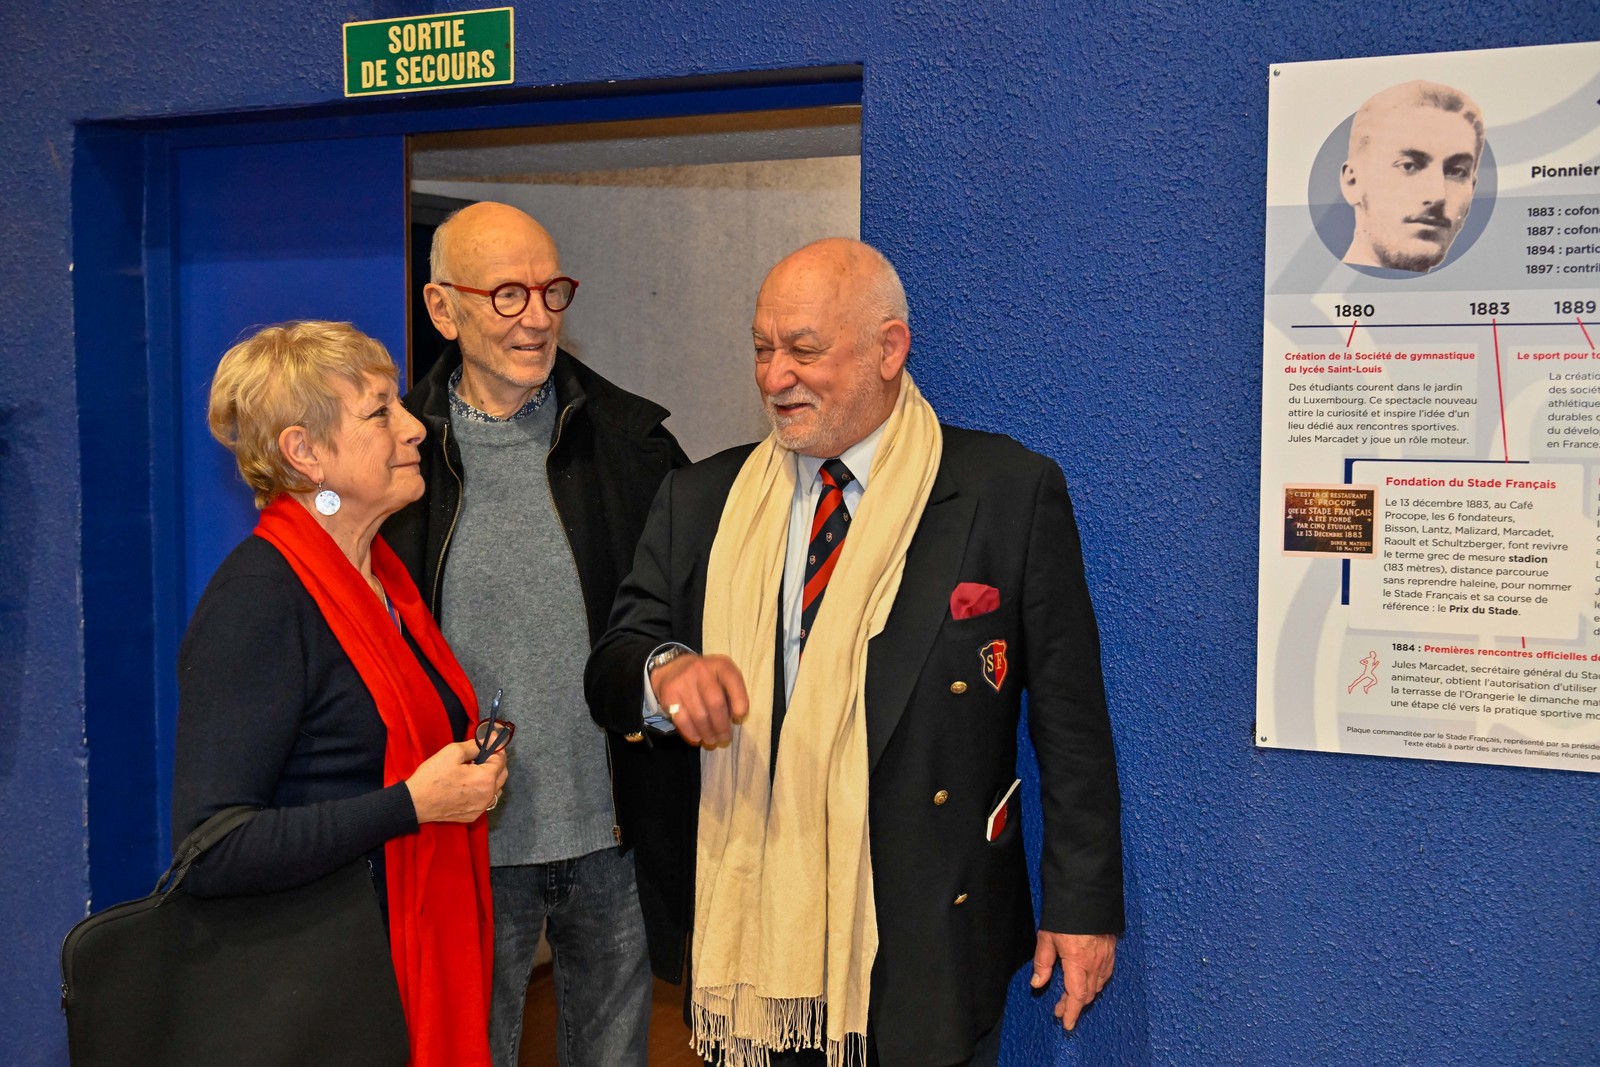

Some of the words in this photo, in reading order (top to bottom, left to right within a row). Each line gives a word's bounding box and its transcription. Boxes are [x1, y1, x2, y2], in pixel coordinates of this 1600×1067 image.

[389, 20, 465, 54] SORTIE
[362, 60, 388, 88] DE
[396, 50, 495, 85] SECOURS
[1528, 207, 1554, 217] 1883
[1527, 226, 1554, 236] 1887
[1527, 245, 1555, 255] 1894
[1526, 265, 1553, 274] 1897
[1335, 305, 1375, 317] 1880
[1470, 302, 1510, 315] 1883
[1554, 301, 1596, 314] 1889
[1355, 352, 1392, 360] Société
[1410, 352, 1475, 361] gymnastique
[1533, 352, 1560, 361] sport
[1300, 365, 1325, 375] lycée
[1434, 383, 1462, 392] jardin
[1549, 386, 1567, 394] des
[1304, 396, 1366, 405] Luxembourg.
[1386, 397, 1432, 405] spectacle
[1384, 410, 1416, 418] inspire
[1548, 413, 1593, 421] durables
[1307, 422, 1333, 430] dédié
[1411, 423, 1459, 432] sportives.
[1315, 435, 1359, 443] Marcadet
[1370, 436, 1391, 444] joue
[1386, 477, 1445, 487] Fondation
[1449, 478, 1463, 487] du
[1468, 479, 1502, 488] Stade
[1506, 480, 1556, 490] Français
[1413, 499, 1463, 508] décembre
[1466, 500, 1491, 509] 1883,
[1510, 501, 1533, 510] Café
[1334, 508, 1372, 516] FRANÇAIS
[1385, 511, 1429, 521] Procope,
[1448, 513, 1455, 521] 6
[1458, 513, 1515, 523] fondateurs,
[1385, 524, 1419, 534] Bisson,
[1422, 526, 1452, 535] Lantz,
[1455, 527, 1500, 536] Malizard,
[1503, 528, 1554, 538] Marcadet,
[1385, 537, 1416, 546] Raoult
[1432, 539, 1505, 550] Schultzberger,
[1509, 541, 1529, 549] font
[1533, 542, 1568, 551] revivre
[1509, 555, 1548, 563] stadion
[1384, 563, 1404, 572] (183
[1407, 564, 1447, 574] mètres),
[1450, 566, 1493, 575] distance
[1496, 569, 1549, 577] parcourue
[1408, 578, 1457, 586] reprendre
[1460, 579, 1498, 589] haleine,
[1383, 589, 1391, 597] le
[1394, 589, 1423, 598] Stade
[1426, 591, 1468, 601] Français
[1535, 596, 1548, 604] de
[1383, 602, 1429, 611] référence
[1450, 605, 1469, 613] Prix
[1488, 607, 1520, 616] Stade.
[1424, 645, 1474, 655] Premières
[1478, 648, 1533, 658] rencontres
[1536, 651, 1587, 661] officielles
[1392, 661, 1416, 669] Jules
[1420, 662, 1468, 673] Marcadet,
[1471, 666, 1520, 675] secrétaire
[1524, 668, 1562, 677] général
[1565, 670, 1578, 678] du
[1392, 674, 1442, 684] animateur,
[1446, 677, 1481, 686] obtient
[1485, 679, 1550, 690] l'autorisation
[1553, 683, 1597, 693] d'utiliser
[1402, 688, 1441, 696] terrasse
[1460, 690, 1515, 701] l'Orangerie
[1518, 694, 1526, 702] le
[1530, 695, 1580, 705] dimanche
[1411, 700, 1439, 710] étape
[1483, 705, 1491, 713] la
[1495, 707, 1537, 716] pratique
[1540, 710, 1582, 719] sportive
[1469, 735, 1502, 744] Français,
